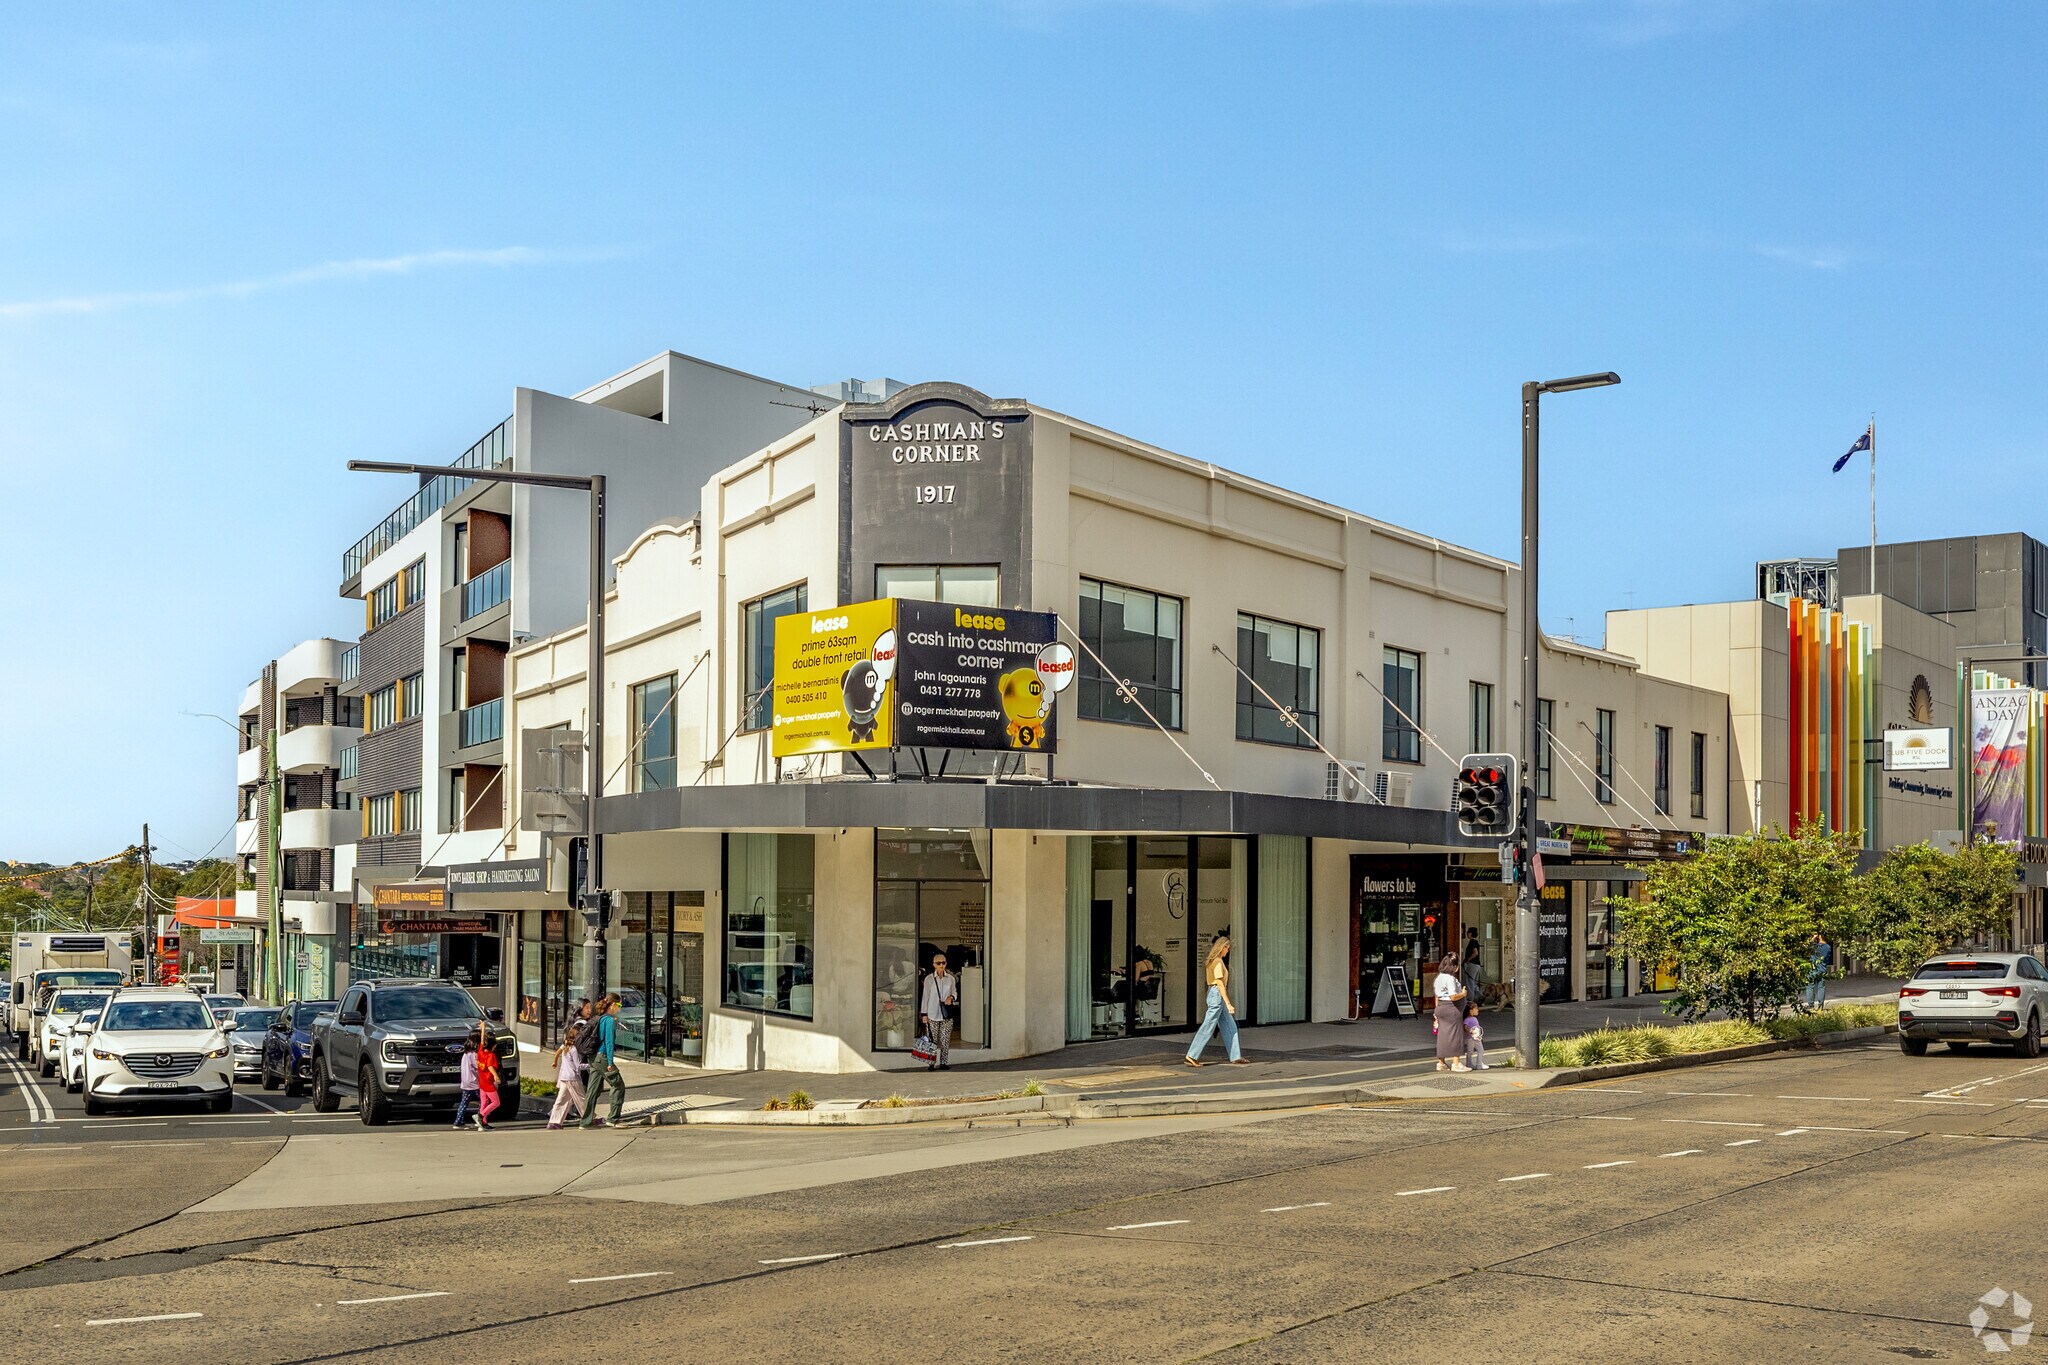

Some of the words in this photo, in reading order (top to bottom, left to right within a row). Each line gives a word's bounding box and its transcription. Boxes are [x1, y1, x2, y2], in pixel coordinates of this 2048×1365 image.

[869, 420, 1005, 442] CASHMAN'S
[892, 444, 981, 463] CORNER
[916, 485, 956, 503] 1917
[811, 615, 849, 634] lease
[955, 607, 1006, 631] lease
[801, 639, 826, 655] prime
[827, 635, 857, 651] 63sqm
[907, 630, 944, 647] cash
[948, 632, 974, 650] into
[792, 656, 821, 670] double
[823, 653, 843, 665] front
[844, 648, 867, 662] retail
[957, 654, 1005, 669] corner
[1038, 657, 1074, 673] leased
[776, 681, 801, 692] michelle
[802, 676, 839, 689] bernardinis
[914, 670, 936, 682] john
[938, 671, 987, 685] lagounaris
[920, 685, 942, 695] 0431
[945, 687, 963, 698] 277
[964, 688, 981, 698] 778
[1030, 684, 1040, 693] m
[785, 695, 801, 705] 0400
[802, 693, 814, 703] 505
[814, 691, 828, 701] 410
[1975, 695, 2028, 708] ANZAC
[782, 716, 795, 725] roger
[914, 706, 935, 716] roger
[935, 707, 968, 718] mickhail
[968, 709, 1001, 720] property
[1987, 709, 2016, 721] DAY
[461, 871, 476, 884] BARBER
[476, 871, 487, 884] SHOP
[524, 868, 540, 882] SALON
[1363, 876, 1395, 893] flowers
[1396, 877, 1405, 893] to
[1405, 877, 1416, 893] be
[1541, 885, 1565, 899] lease
[693, 911, 703, 921] ASH
[1540, 912, 1555, 923] brand
[1555, 914, 1567, 922] new
[400, 923, 449, 931] CHANTARA
[1555, 925, 1568, 938] shop
[656, 941, 663, 953] 75
